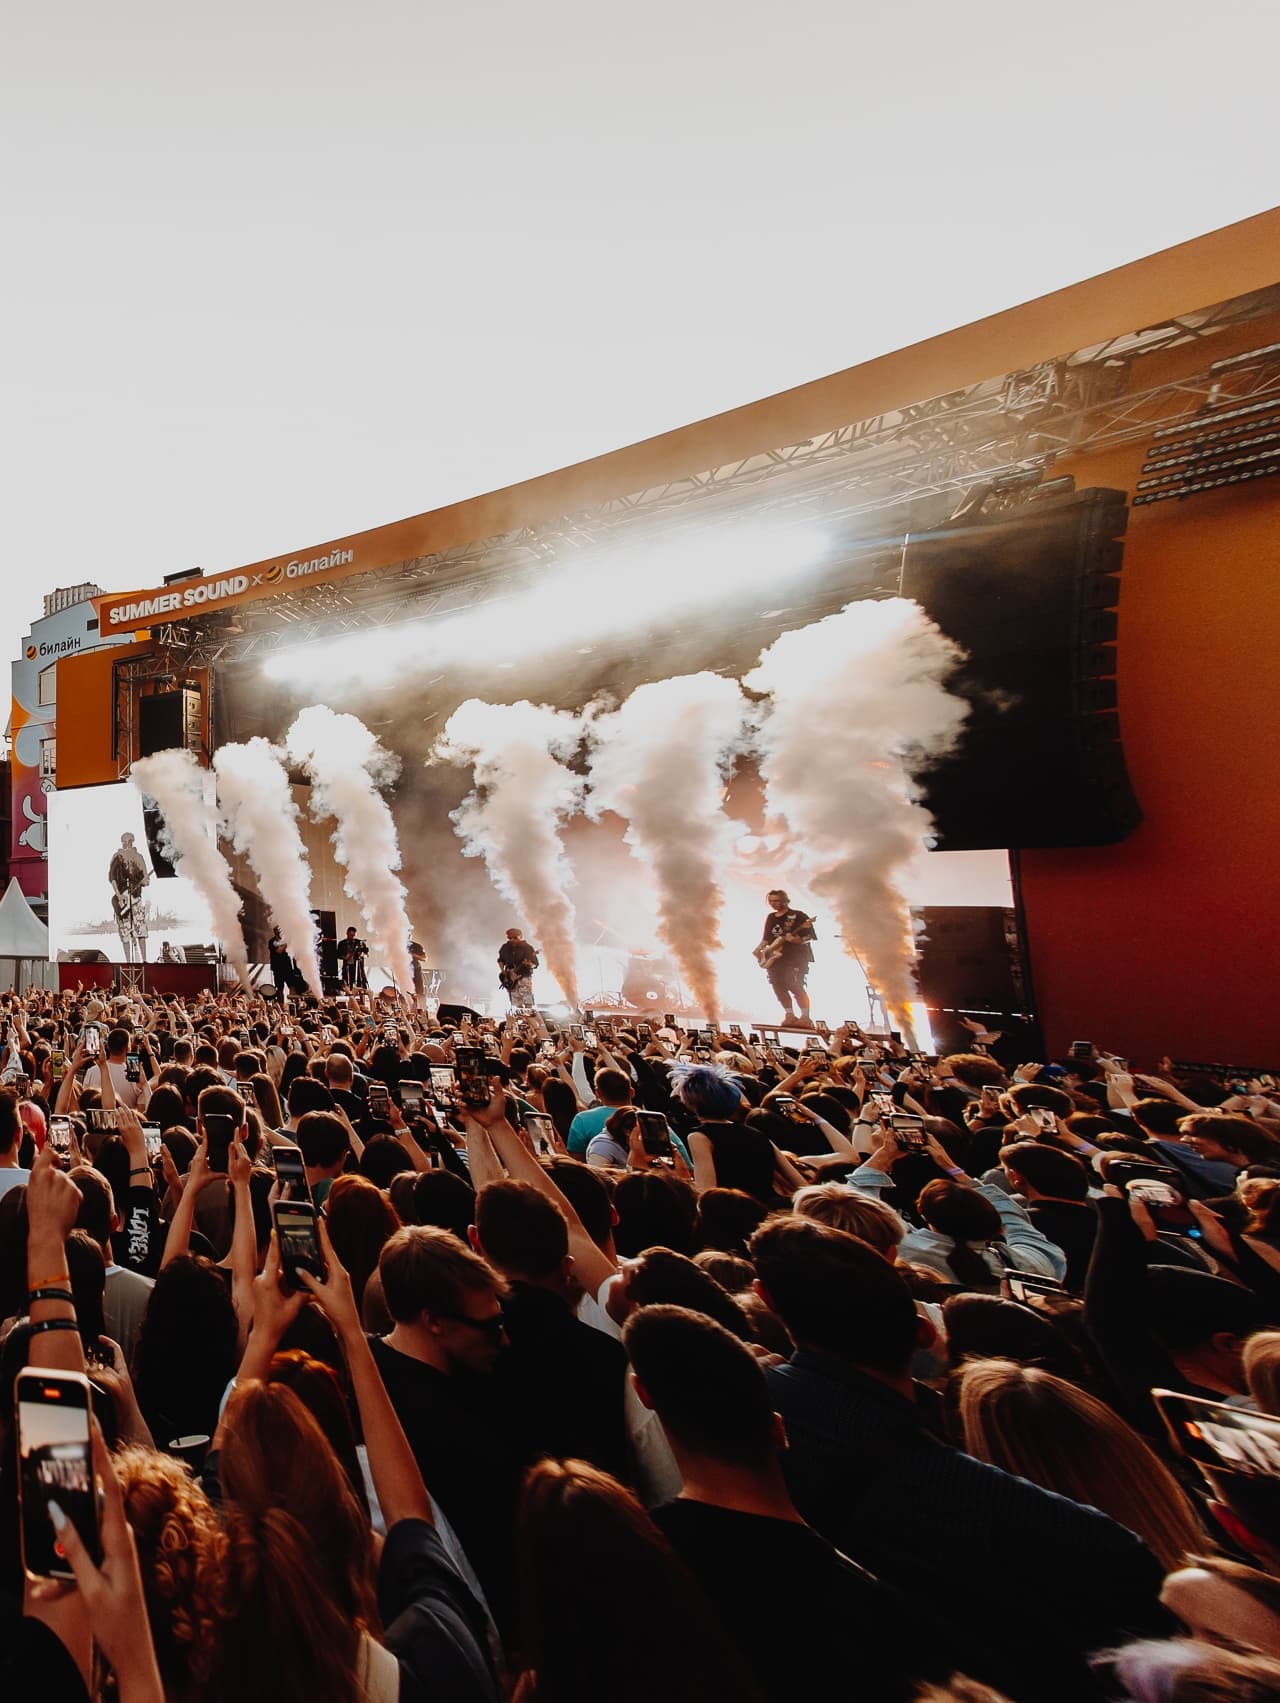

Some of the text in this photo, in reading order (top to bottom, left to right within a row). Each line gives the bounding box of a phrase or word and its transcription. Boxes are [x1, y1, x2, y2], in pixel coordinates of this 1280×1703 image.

[286, 550, 354, 579] билайн
[109, 594, 182, 624] SUMMER
[183, 575, 247, 607] SOUND
[39, 636, 81, 656] билайн
